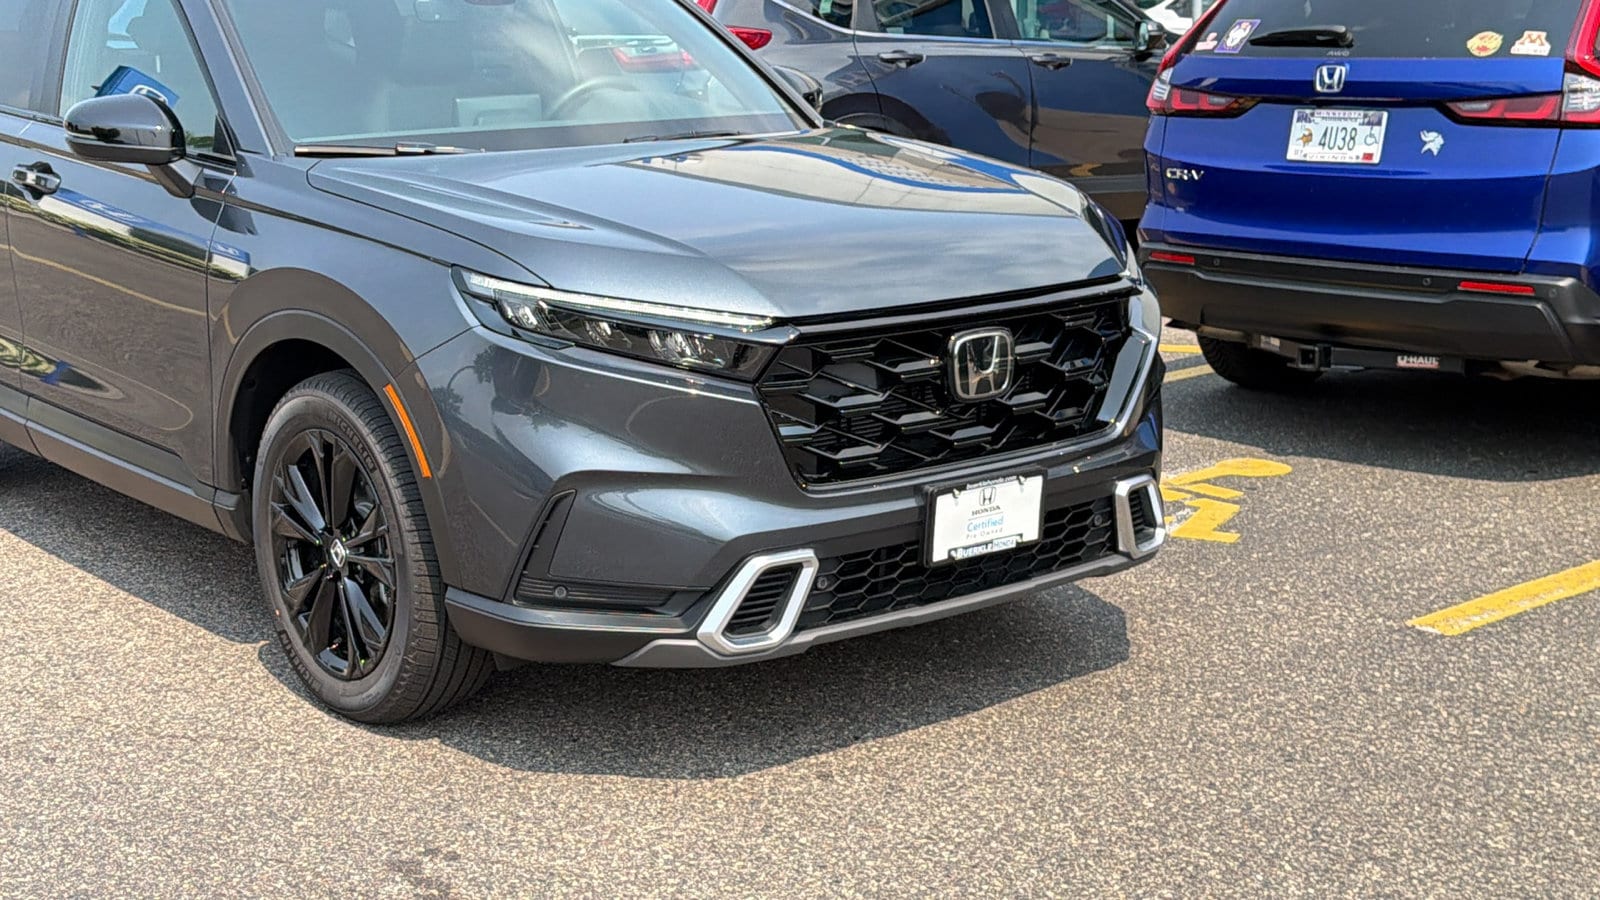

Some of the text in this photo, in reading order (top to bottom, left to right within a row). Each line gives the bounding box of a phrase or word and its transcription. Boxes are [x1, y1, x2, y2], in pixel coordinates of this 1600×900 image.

[1318, 126, 1359, 151] 4U38
[1166, 168, 1205, 180] CR-V
[1396, 355, 1440, 366] U-HAUL
[971, 505, 1001, 516] HONDA
[967, 516, 1004, 532] Certified
